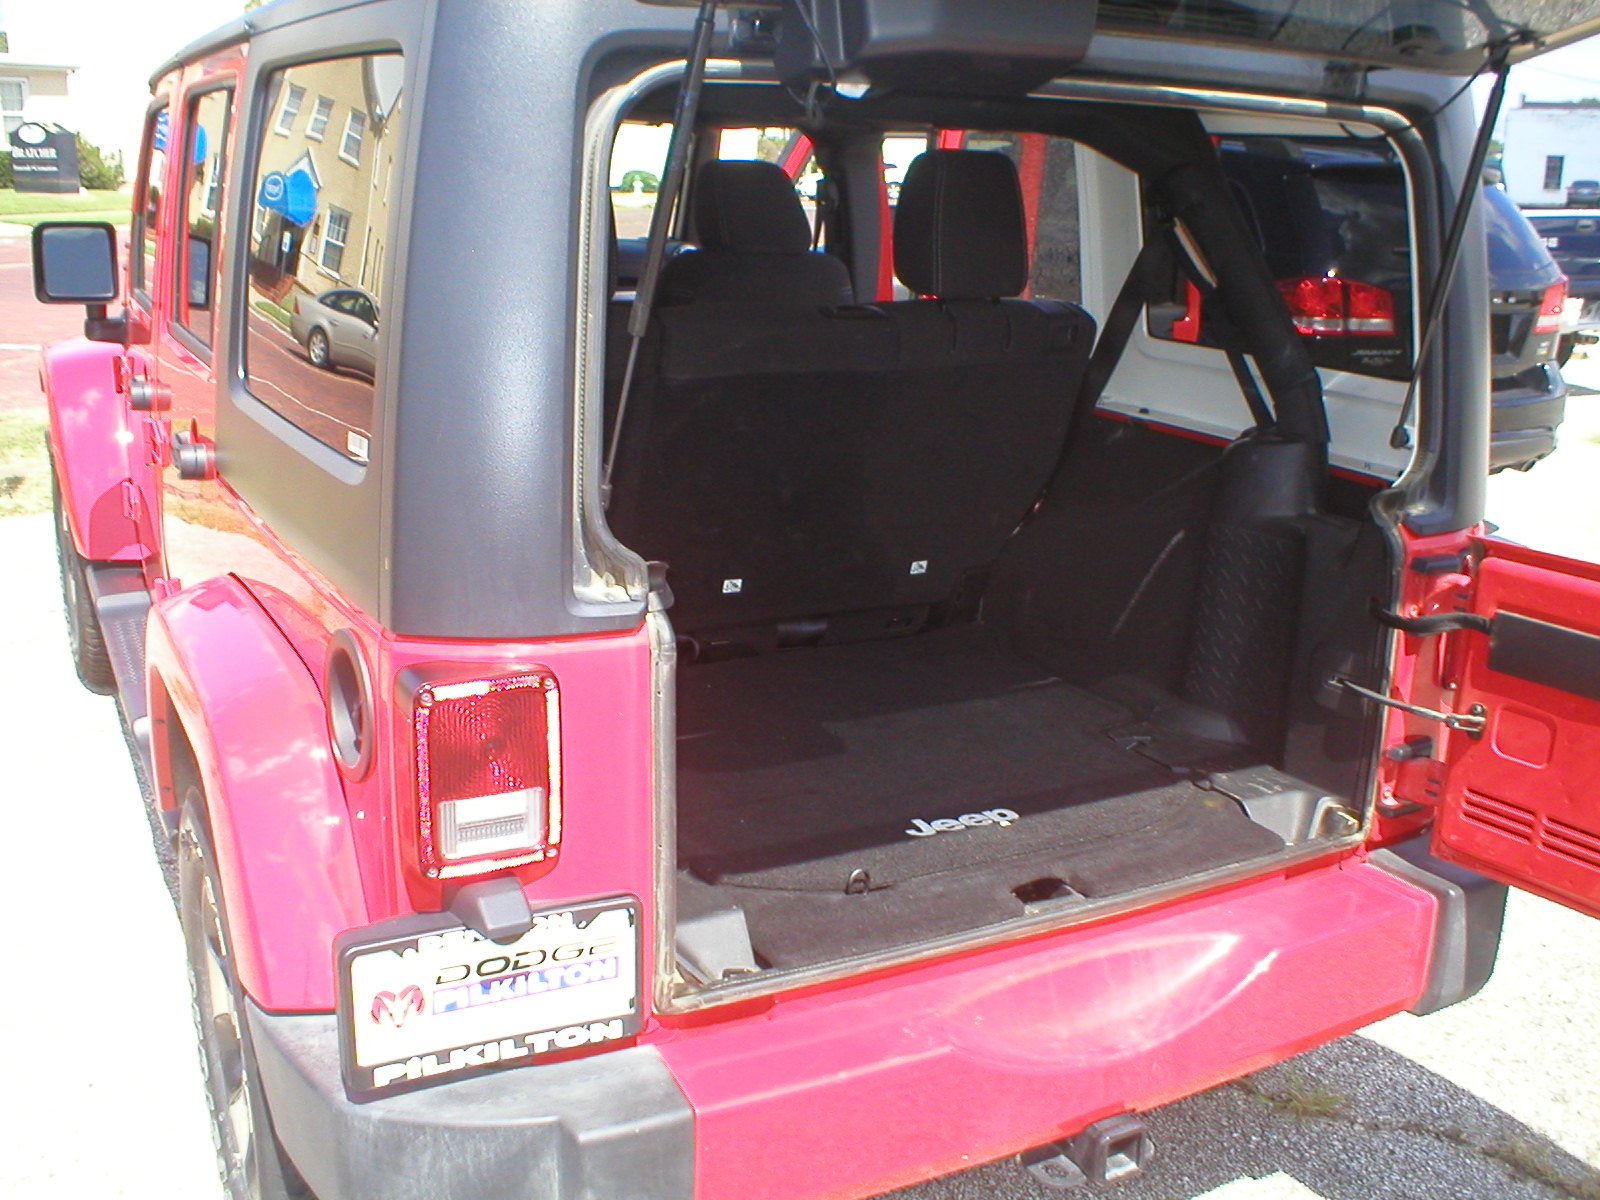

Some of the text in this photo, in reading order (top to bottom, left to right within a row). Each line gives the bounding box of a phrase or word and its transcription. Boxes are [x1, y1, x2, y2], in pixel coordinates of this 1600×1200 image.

[905, 808, 1019, 837] Jeep
[433, 957, 619, 1014] PILKILTON
[436, 937, 619, 984] DODGE
[373, 1019, 623, 1087] PILKILTON
